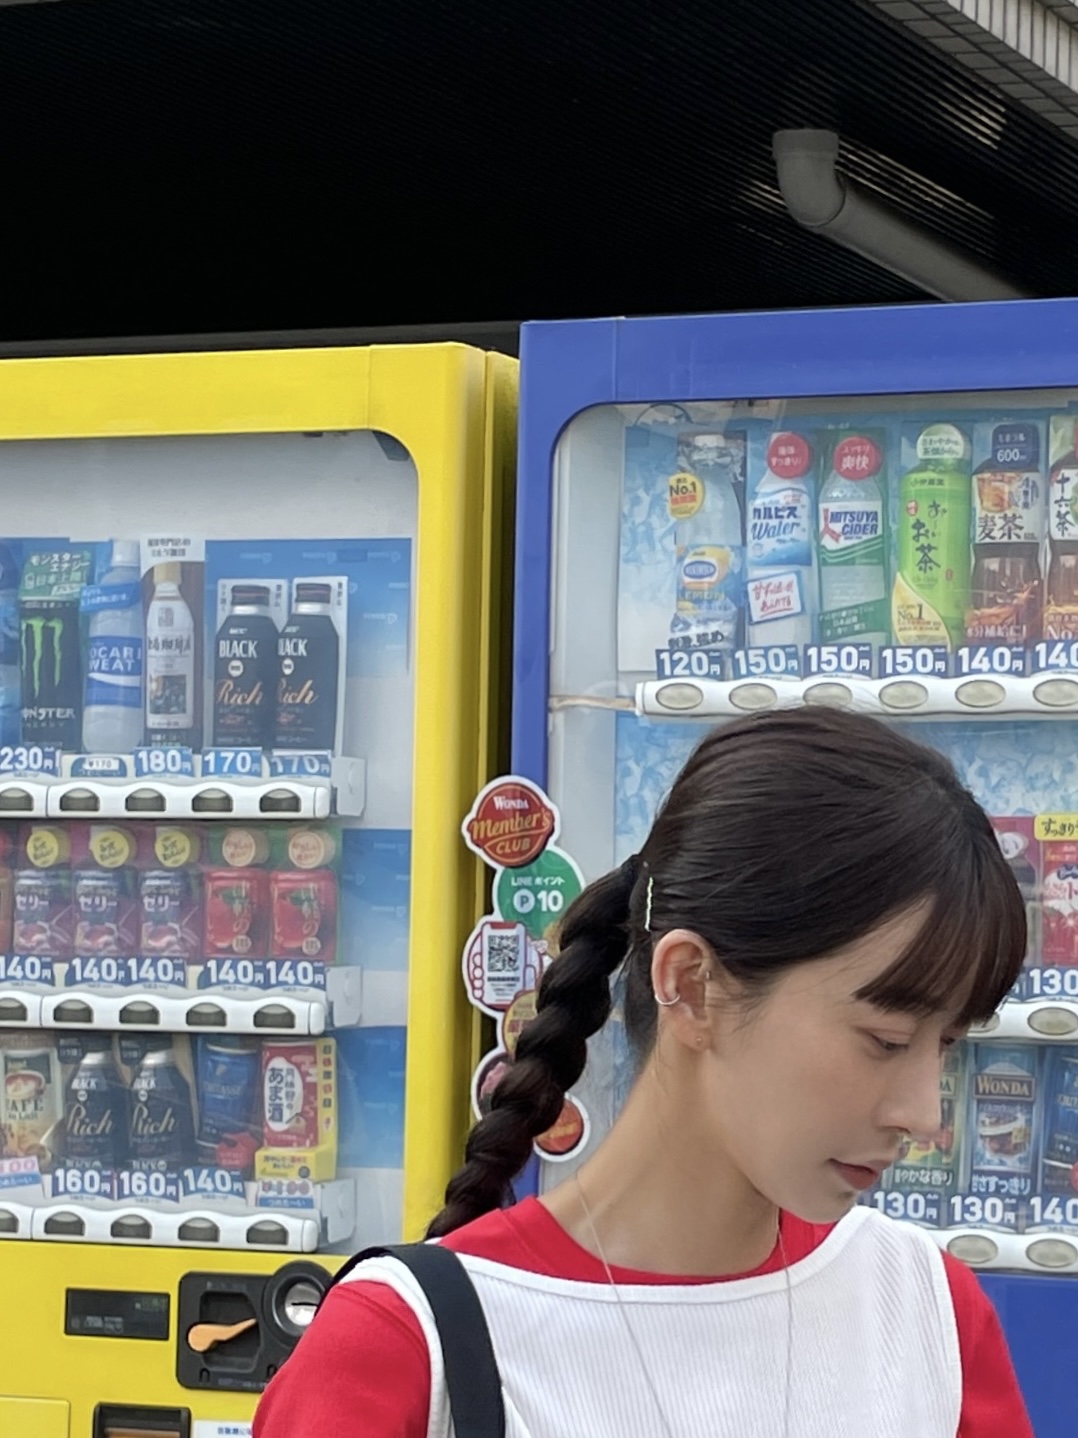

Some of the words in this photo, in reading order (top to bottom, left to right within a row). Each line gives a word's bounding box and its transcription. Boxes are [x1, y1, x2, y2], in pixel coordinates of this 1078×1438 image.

[669, 481, 697, 497] No.1
[752, 505, 799, 521] カルピス
[1054, 472, 1076, 537] 十六茶
[829, 510, 878, 524] MITSUYA
[977, 513, 1025, 541] 麦茶
[749, 521, 801, 541] Water
[841, 523, 878, 536] CIDER
[89, 647, 142, 659] OCARI
[218, 639, 259, 659] BLACK
[734, 647, 798, 675] 150円
[806, 645, 870, 673] 150円
[881, 647, 946, 674] 150円
[957, 646, 1024, 673] 140円
[88, 659, 135, 672] WEAT
[659, 652, 721, 677] 120円
[215, 678, 264, 706] Rich
[22, 706, 77, 720] ONSTER
[137, 749, 192, 773] 180円
[203, 751, 261, 774] 170円
[271, 755, 330, 774] 170円
[493, 796, 529, 810] WONDA
[470, 808, 551, 840] Member's
[1041, 818, 1076, 837] すっきり
[495, 838, 531, 855] CLUB
[511, 876, 533, 887] LINE
[534, 876, 566, 886] ポイント
[16, 894, 49, 911] ゼリー
[79, 894, 118, 912] ゼリー
[142, 895, 181, 912] ゼリー
[537, 889, 564, 912] 10
[0, 956, 52, 981] 140円
[127, 958, 185, 982] 140円
[206, 959, 265, 985] 140円
[265, 960, 325, 985] 140円
[267, 1066, 285, 1123] あま酒
[977, 1074, 1031, 1097] WONDA
[66, 1103, 113, 1136] Rich
[132, 1103, 176, 1136] Rich
[54, 1168, 112, 1194] 160円
[119, 1171, 177, 1197] 160円
[183, 1167, 244, 1193] 140円
[873, 1191, 938, 1219] 130円
[951, 1195, 1016, 1224] 130円
